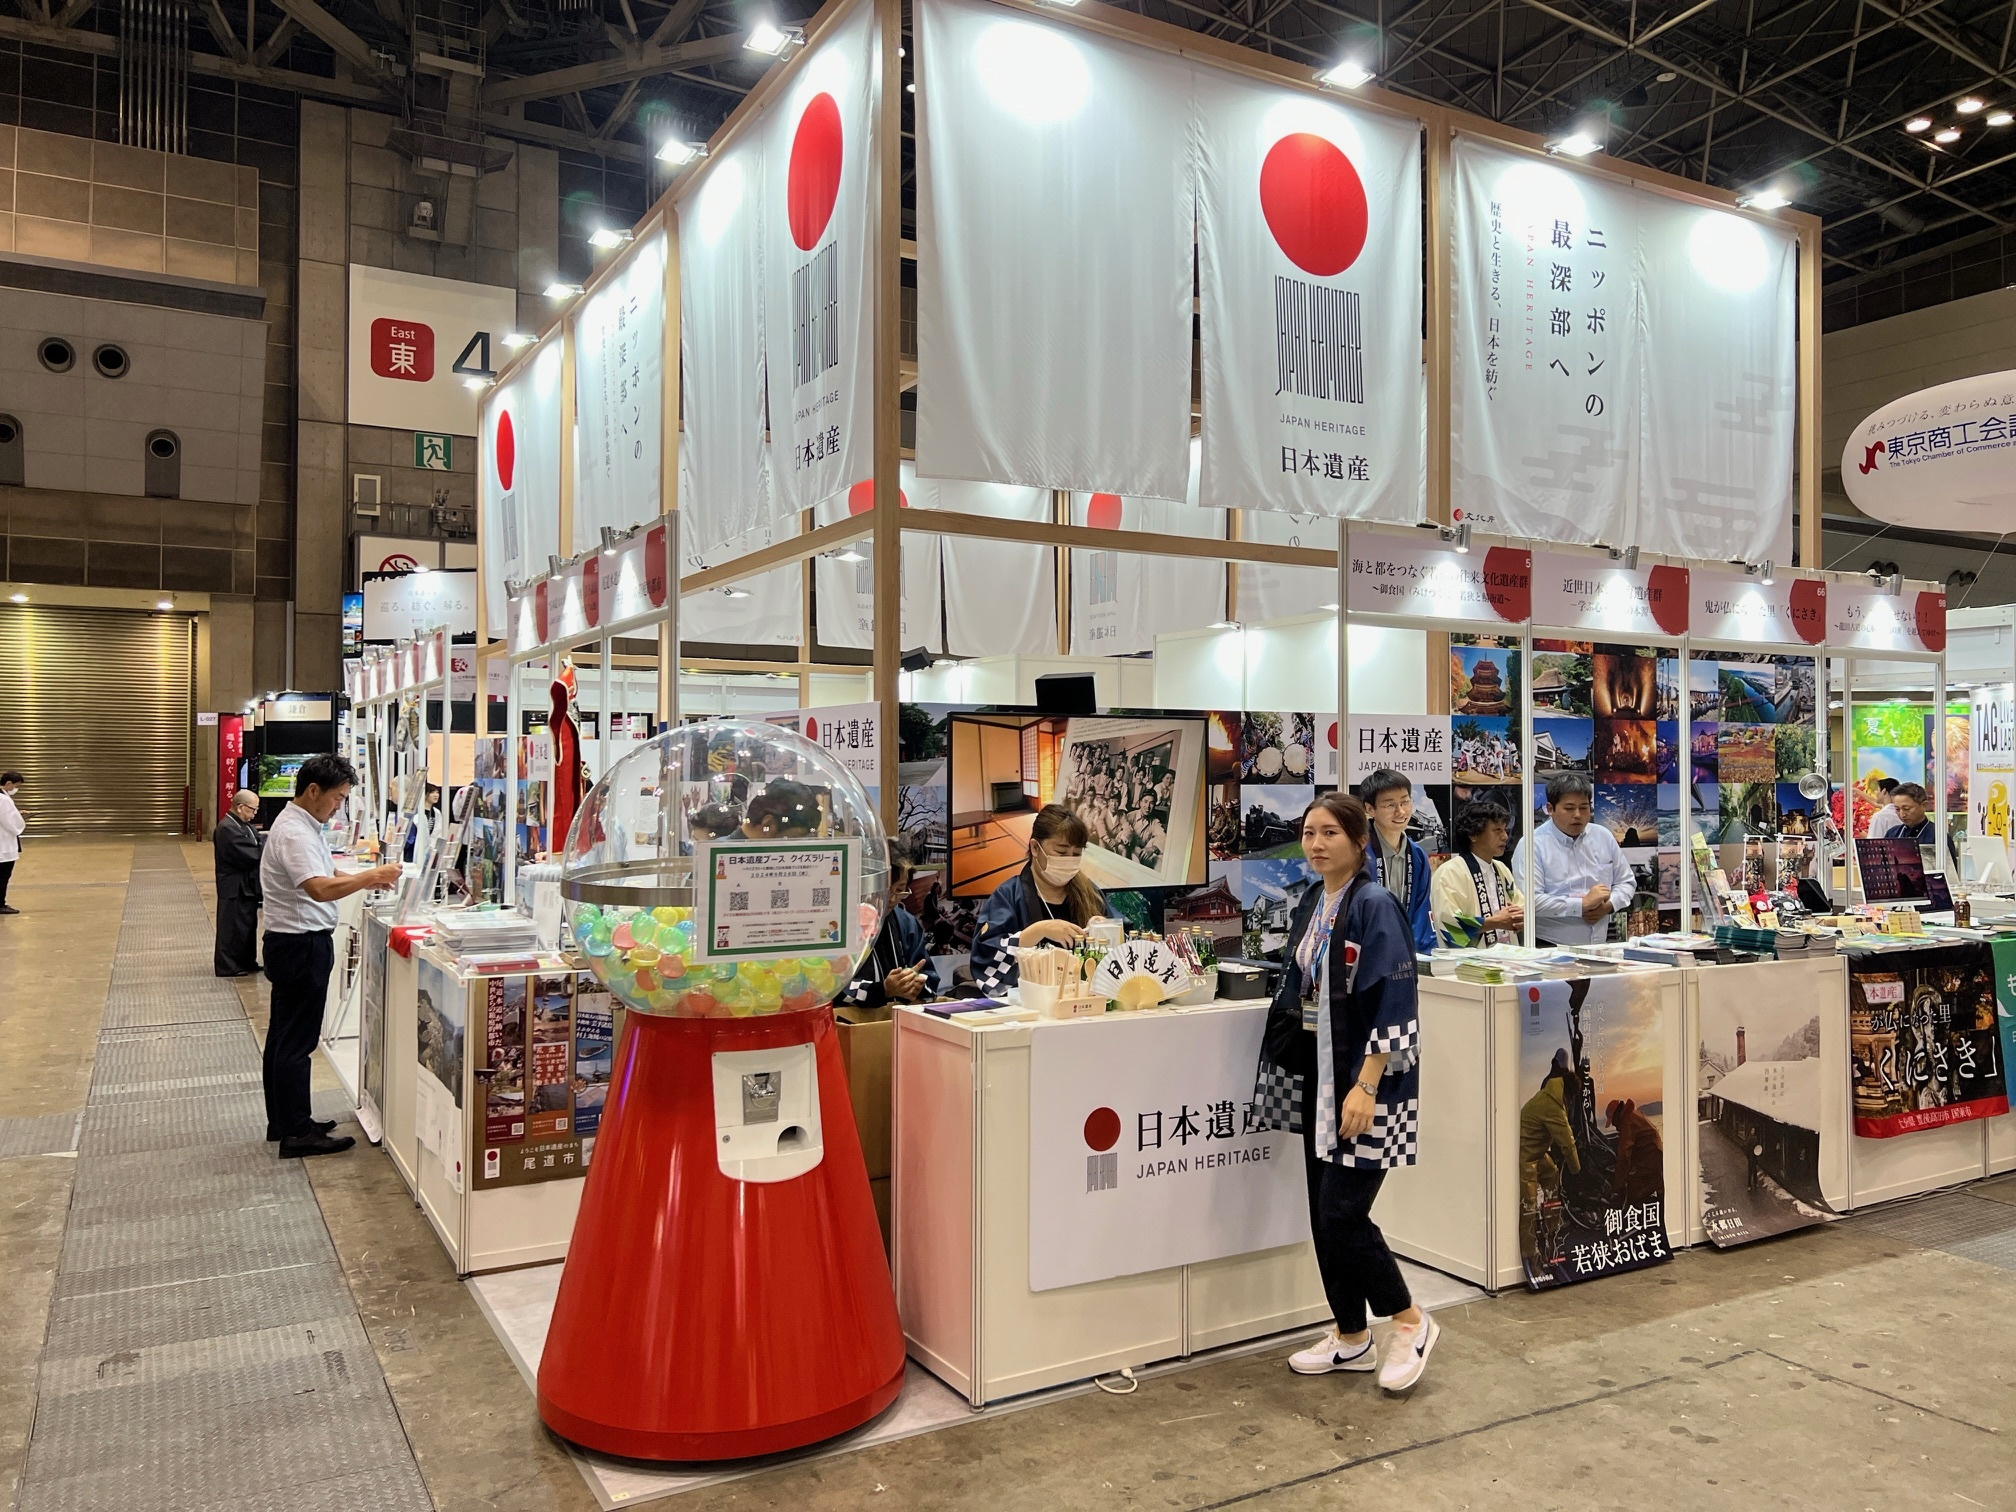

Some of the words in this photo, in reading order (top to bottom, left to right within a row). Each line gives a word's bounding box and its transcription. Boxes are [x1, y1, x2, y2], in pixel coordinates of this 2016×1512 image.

[1549, 218, 1573, 377] 最深部へ
[391, 326, 416, 341] East
[1585, 227, 1607, 417] ニッポンの
[389, 342, 416, 375] 東
[451, 331, 498, 377] 4
[794, 407, 811, 425] APAN
[1280, 413, 1310, 429] JAPAN
[1314, 420, 1366, 436] HERITAGE
[795, 425, 841, 474] 日本遺産
[1281, 445, 1371, 481] 日本遺産
[1889, 461, 1901, 469] The
[1901, 457, 1921, 467] Tokyo
[1921, 450, 1955, 462] Chamber
[1956, 447, 1964, 455] of
[1966, 441, 2012, 454] Commerce
[1525, 558, 1531, 569] 5
[1684, 575, 1688, 585] 1
[1816, 588, 1826, 597] 66
[1938, 599, 1947, 608] 98
[822, 717, 875, 750] 日本遺産
[1358, 726, 1443, 754] 日本遺産
[1975, 701, 1998, 752] TAG
[1358, 761, 1391, 771] JAPAN
[1394, 761, 1443, 772] HERITAGE
[729, 855, 786, 865] 日本遺産ブース
[790, 853, 831, 863] クイズラリー
[523, 1152, 575, 1170] 尾道市
[1136, 1158, 1188, 1180] JAPAN
[1195, 1146, 1271, 1171] HERITAGE
[1603, 1201, 1660, 1237] 御食国
[1570, 1230, 1667, 1275] 若狭おばま
